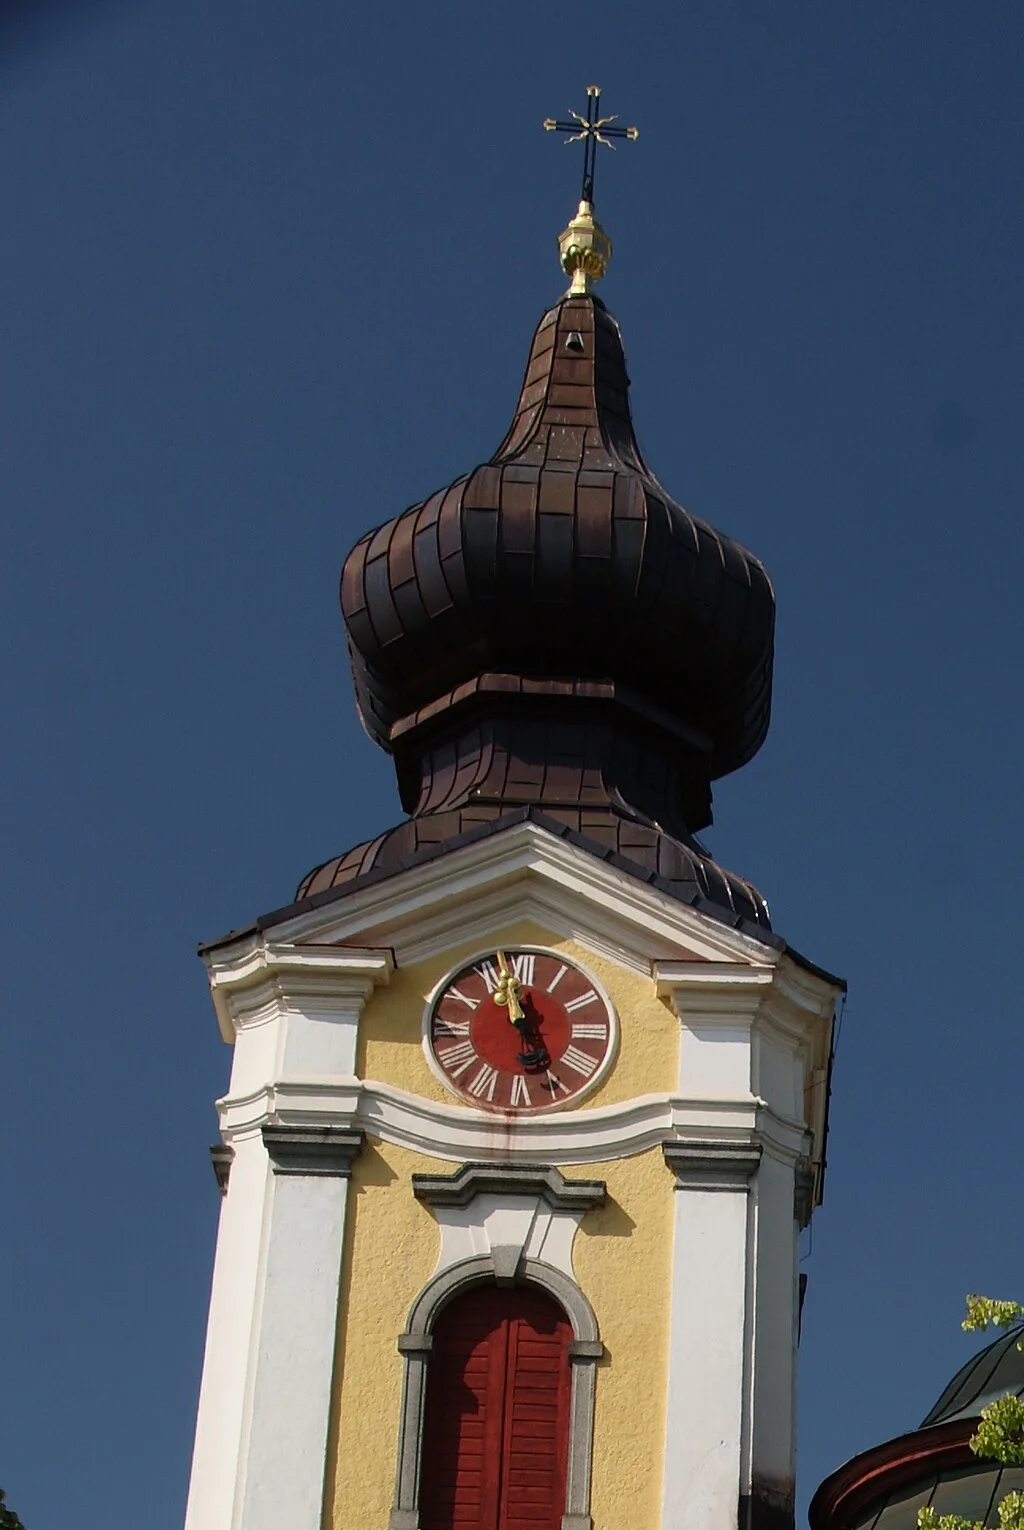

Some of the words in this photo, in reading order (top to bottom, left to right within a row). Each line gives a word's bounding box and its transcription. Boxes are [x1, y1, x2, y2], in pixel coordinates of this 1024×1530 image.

[511, 954, 535, 986] XII
[443, 986, 481, 1010] X
[564, 989, 598, 1013] II
[571, 1023, 607, 1040] III
[438, 1041, 479, 1079] VIII
[560, 1045, 599, 1077] IIII
[467, 1063, 499, 1102] VII
[510, 1075, 531, 1106] VI
